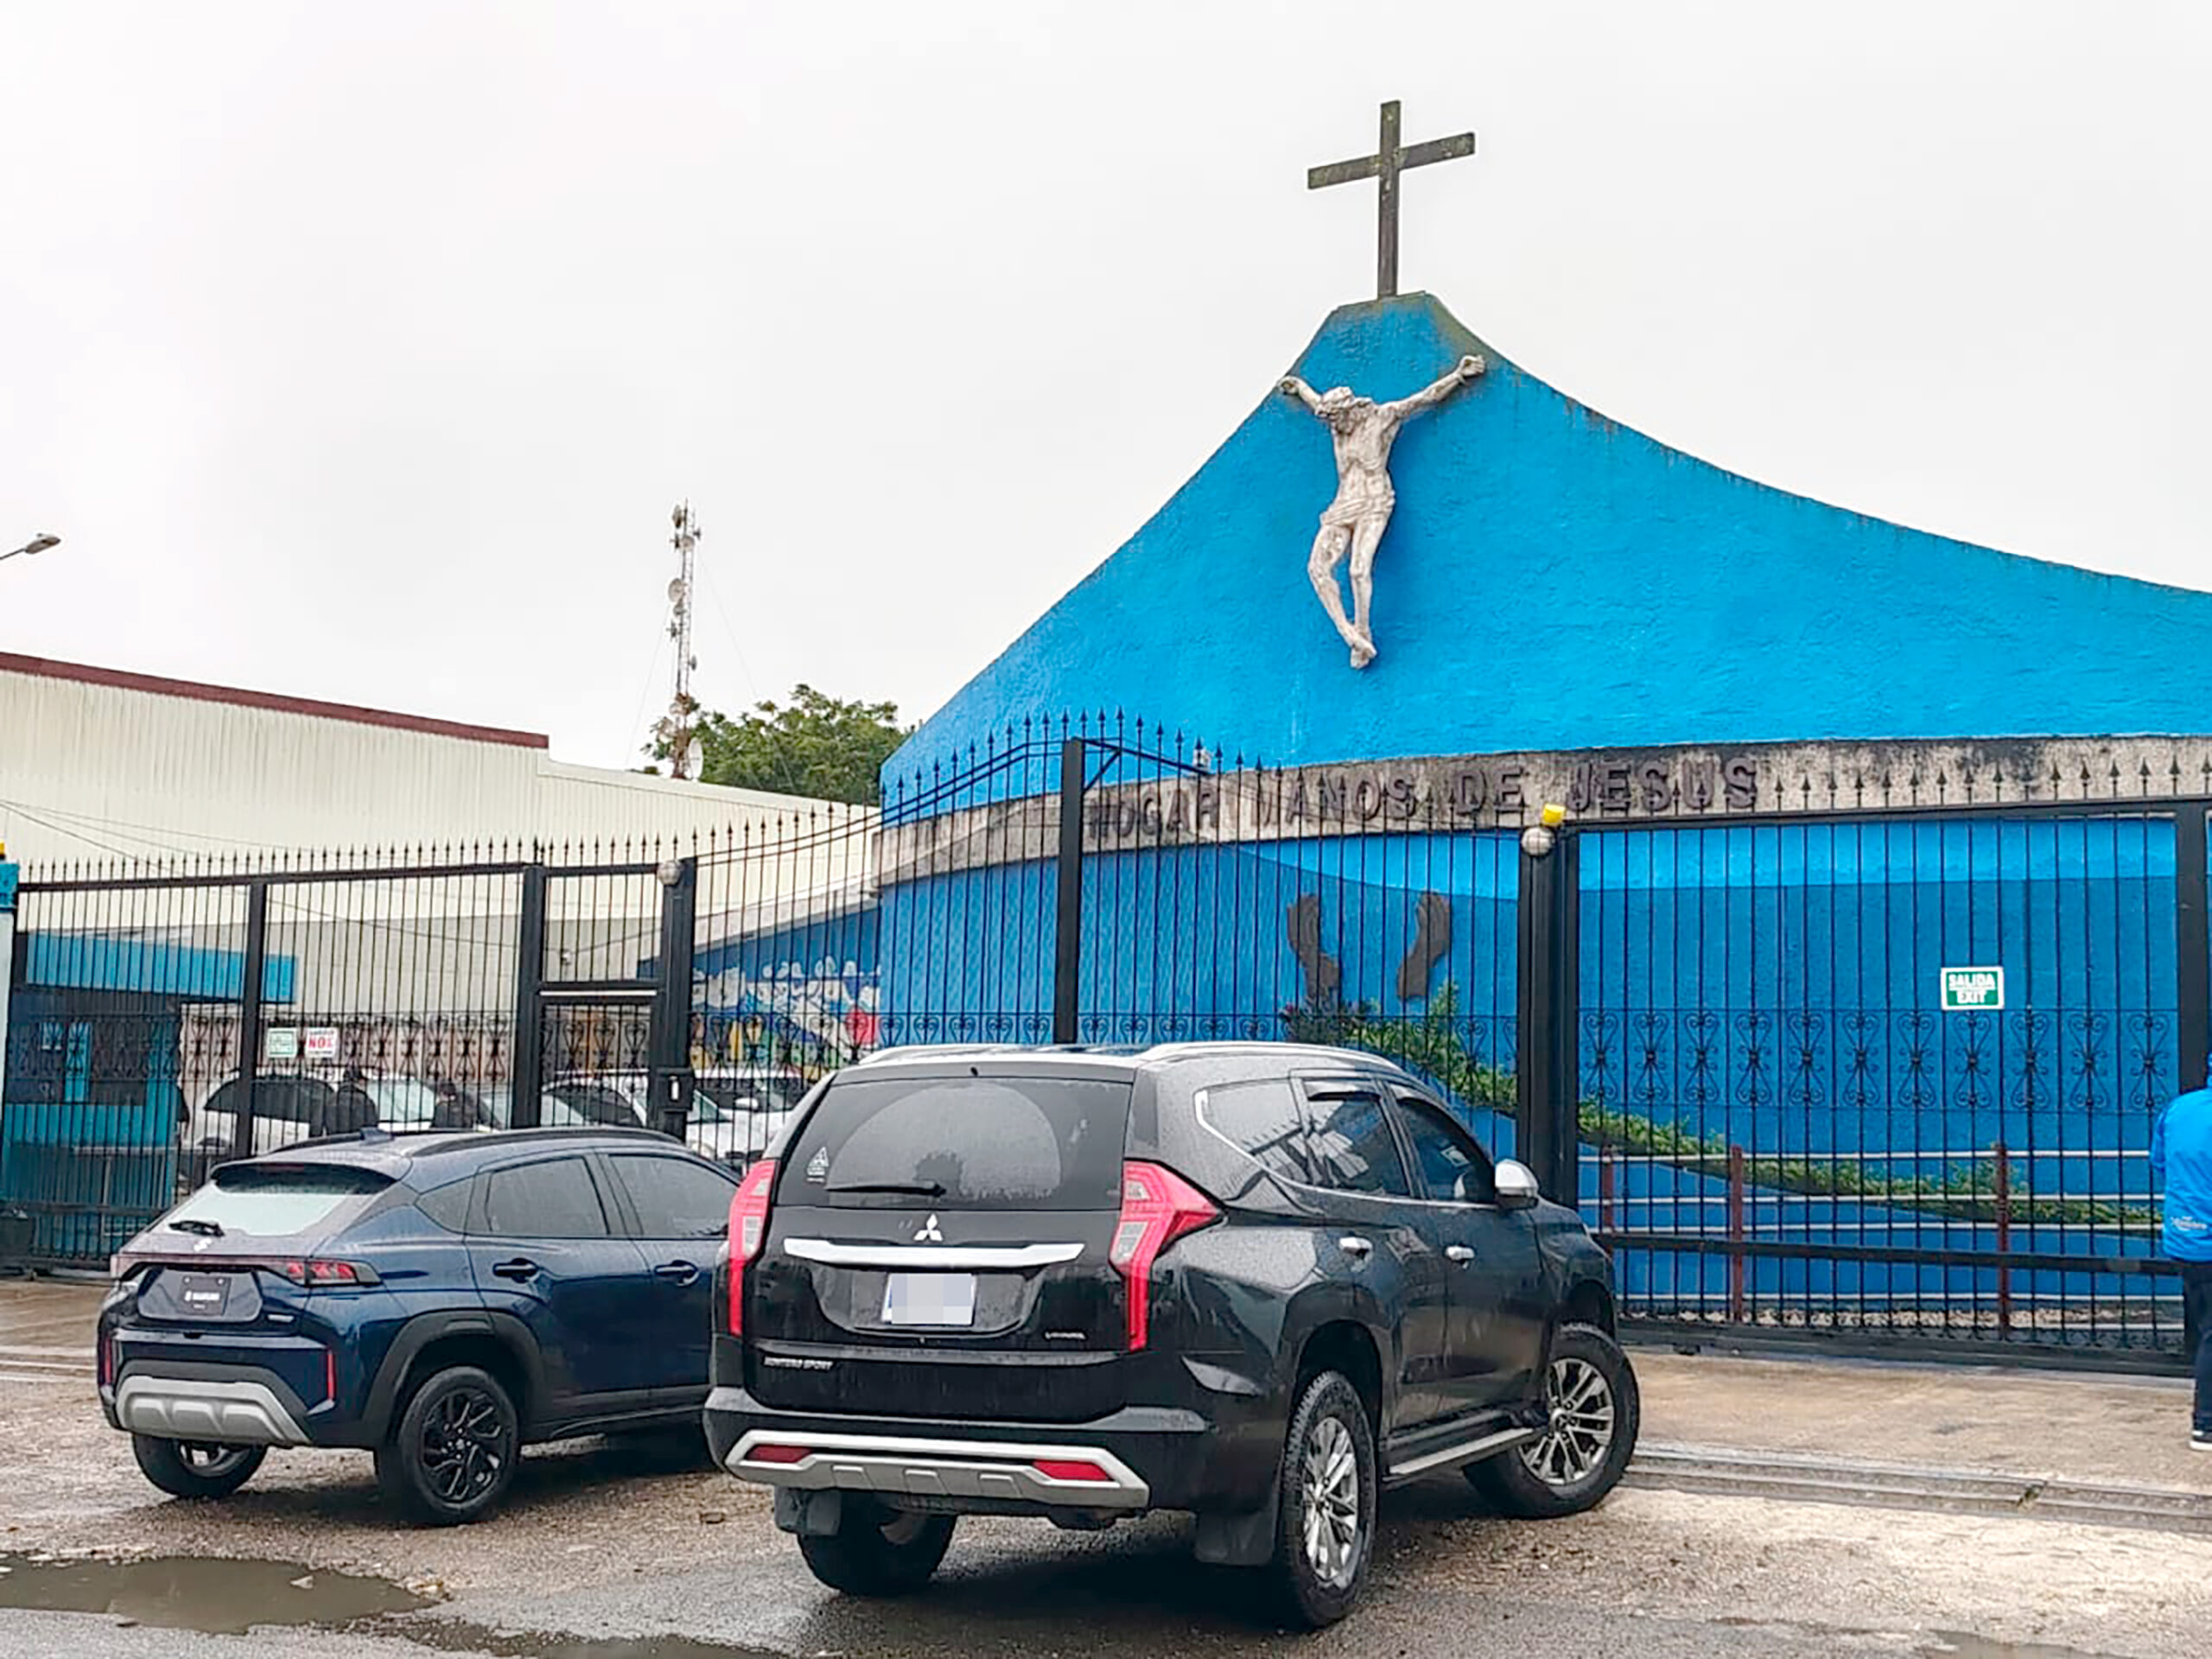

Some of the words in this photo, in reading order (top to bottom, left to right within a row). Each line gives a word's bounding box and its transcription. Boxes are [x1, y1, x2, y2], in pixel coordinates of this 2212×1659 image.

[1453, 766, 1529, 816] DE
[1565, 757, 1758, 812] JESUS
[1948, 974, 1996, 987] SALIDA
[1957, 990, 1986, 1004] EXIT
